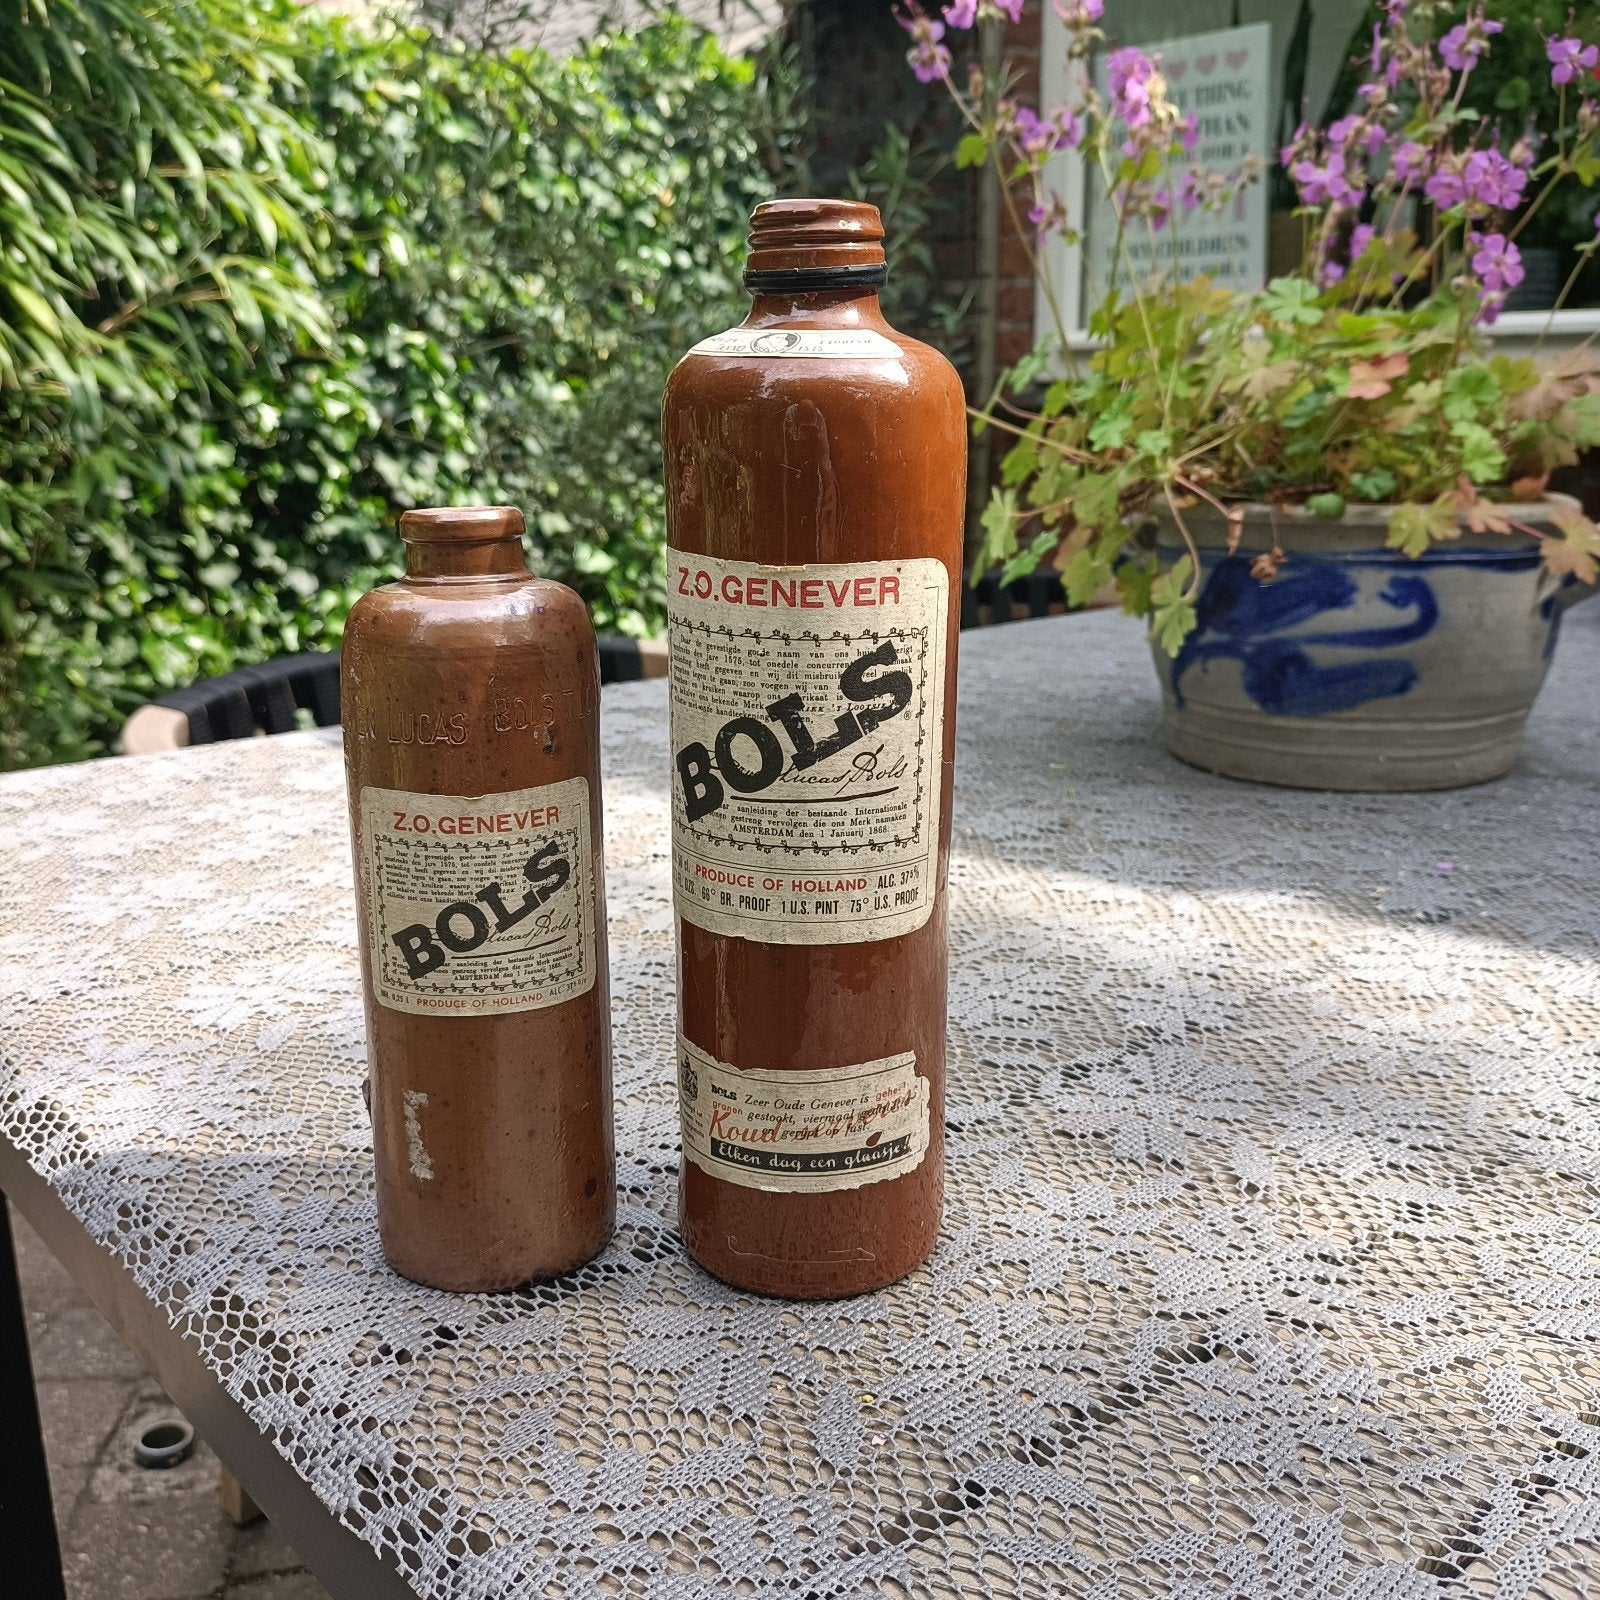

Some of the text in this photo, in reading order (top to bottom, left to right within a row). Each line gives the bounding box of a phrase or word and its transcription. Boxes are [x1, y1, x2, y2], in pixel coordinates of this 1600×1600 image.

[706, 643, 741, 655] gevestigde
[707, 654, 718, 662] jare
[750, 659, 760, 667] tot
[767, 660, 799, 669] onedele
[715, 667, 742, 676] gegeven
[767, 672, 779, 681] wij
[787, 671, 798, 680] dit
[702, 682, 726, 694] kruiken
[733, 690, 760, 700] waarop
[720, 678, 739, 687] gaan,
[761, 682, 789, 692] voegen
[795, 682, 808, 692] wij
[712, 695, 739, 706] bekende
[744, 700, 764, 709] Merk
[388, 712, 470, 746] LUCAS
[676, 640, 912, 823] BOLS
[737, 806, 778, 818] aanleiding
[786, 809, 800, 817] der
[808, 809, 848, 818] bestaande
[855, 801, 908, 816] Internationale
[731, 814, 762, 826] gestreng
[767, 819, 808, 829] vervolgen
[850, 818, 871, 826] Merk
[875, 813, 907, 824] namaken
[733, 824, 795, 838] AMSTERDAM
[800, 830, 814, 838] den
[830, 828, 864, 838] Januarij
[695, 863, 755, 888] PRODUCE
[762, 878, 784, 891] OF
[791, 878, 868, 893] HOLLAND
[877, 874, 896, 889] ALC.
[720, 891, 735, 907] BR.
[739, 895, 771, 912] PROOF
[790, 898, 810, 914] U.S.
[815, 900, 839, 914] PINT
[874, 894, 891, 911] U.S.
[895, 886, 919, 907] PROOF
[391, 840, 571, 980] BOLS
[416, 998, 467, 1008] PRODUCE
[472, 1000, 487, 1008] OF
[493, 993, 543, 1008] HOLLAND
[711, 1084, 738, 1100] BOLS
[745, 1094, 769, 1108] Zeer
[774, 1098, 805, 1110] Oude
[811, 1098, 858, 1110] Genever
[860, 1093, 869, 1103] is
[712, 1100, 743, 1115] granen
[803, 1108, 855, 1123] viermaal
[709, 1110, 782, 1142] Koud
[825, 1127, 840, 1138] op
[719, 1143, 761, 1165] Elken
[769, 1155, 802, 1171] dag
[810, 1159, 836, 1168] een
